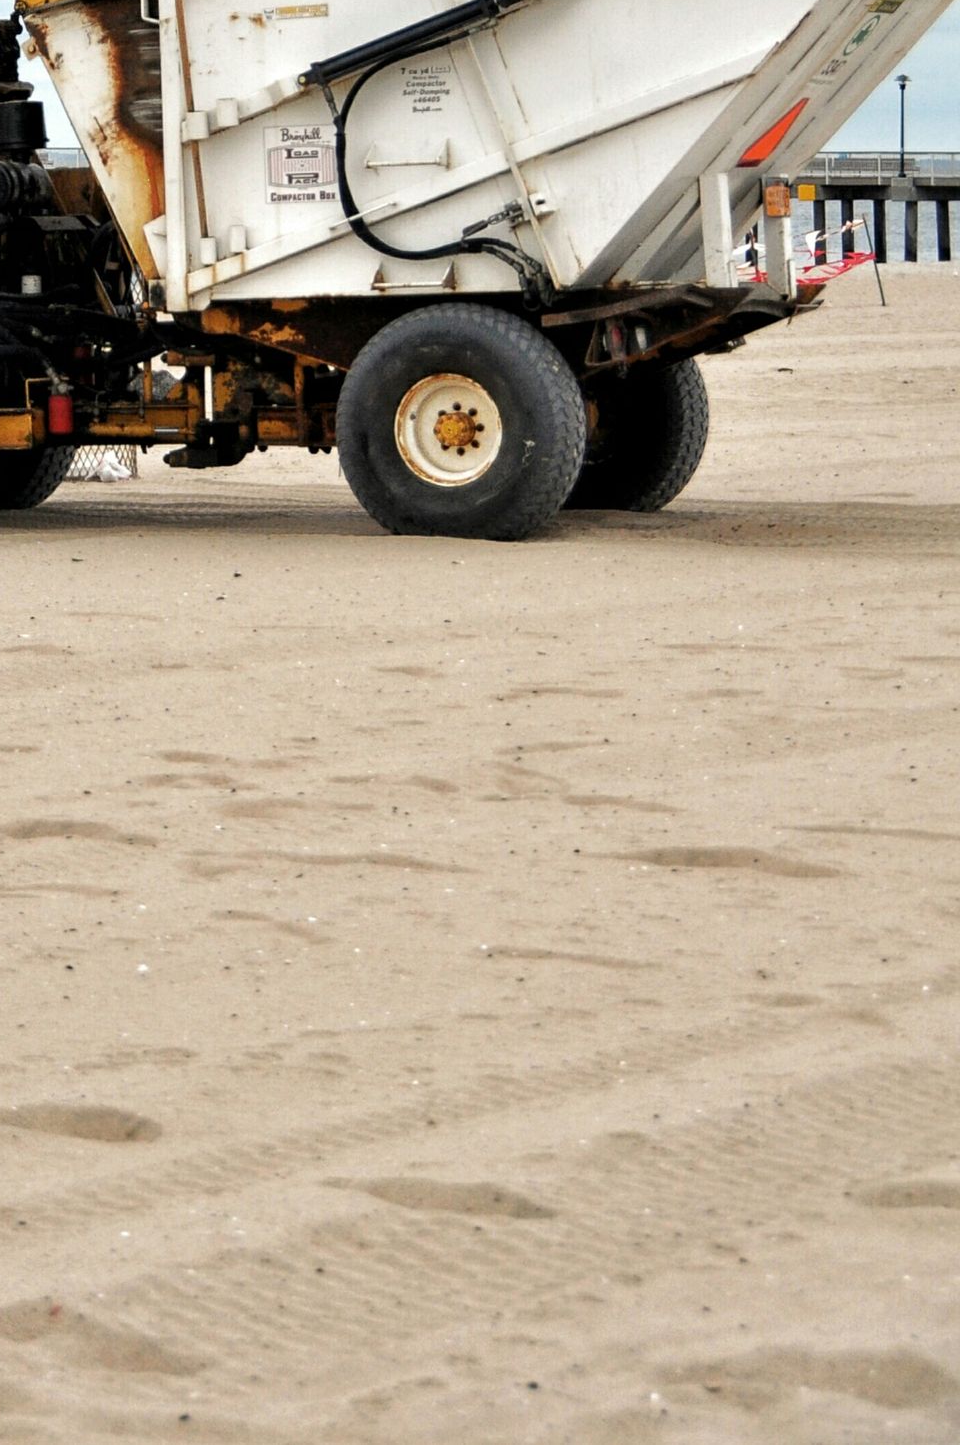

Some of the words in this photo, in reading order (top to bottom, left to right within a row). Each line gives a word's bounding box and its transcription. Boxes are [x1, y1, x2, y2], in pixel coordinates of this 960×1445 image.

[401, 67, 406, 75] 7
[406, 80, 446, 88] Compactor
[280, 127, 322, 142] Broyhill
[286, 173, 320, 185] PACK
[320, 190, 336, 200] BOX
